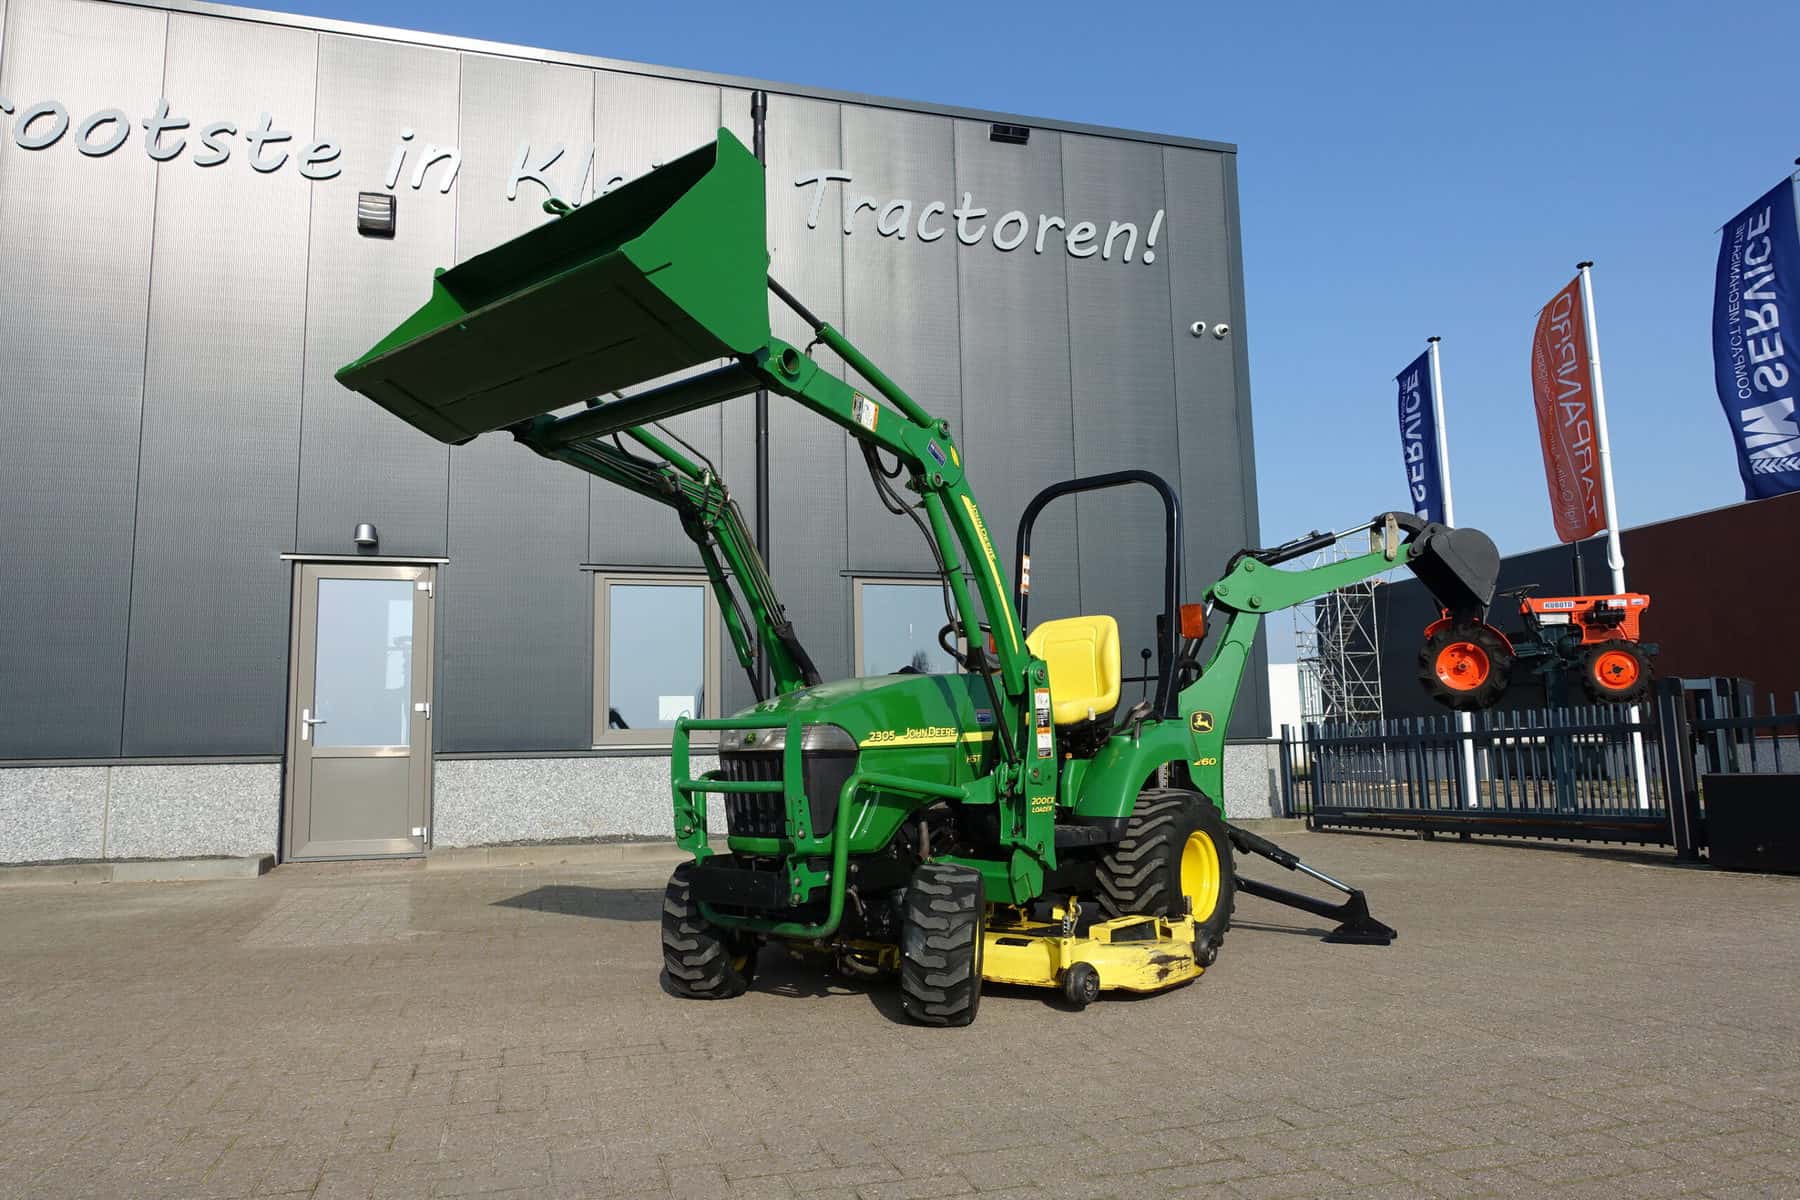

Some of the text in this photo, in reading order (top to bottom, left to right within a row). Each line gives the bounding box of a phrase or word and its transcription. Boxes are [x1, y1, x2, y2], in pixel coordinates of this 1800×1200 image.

[384, 129, 461, 194] in
[795, 169, 1165, 265] Tractoren!
[869, 730, 896, 742] 2305
